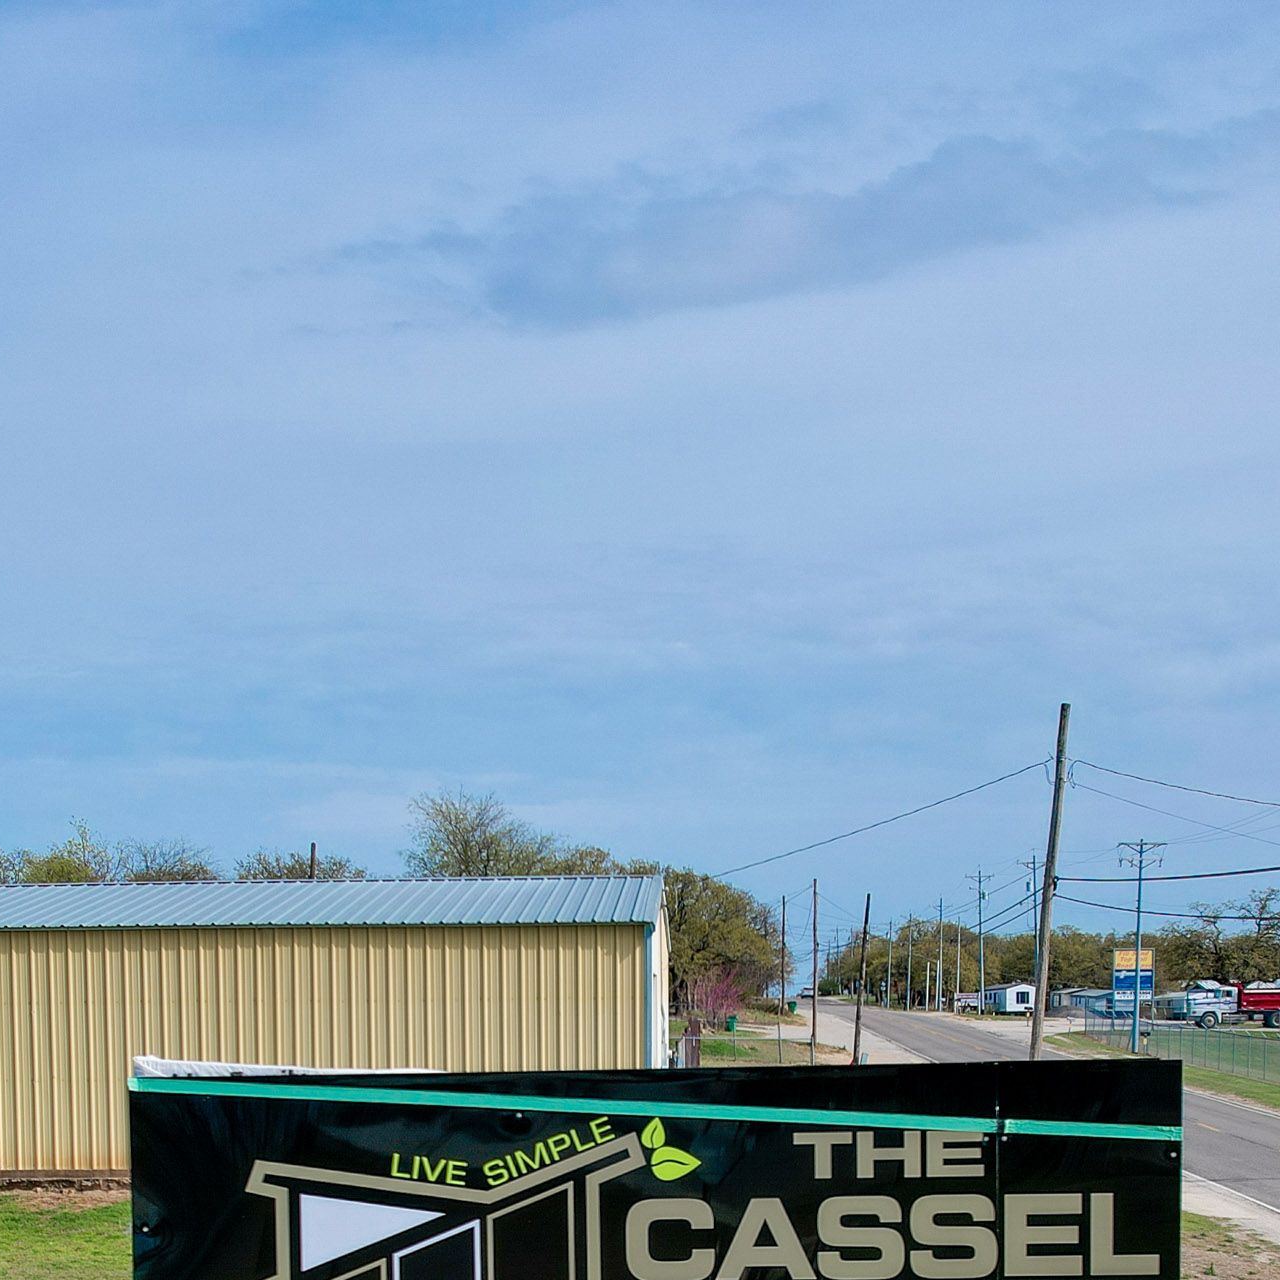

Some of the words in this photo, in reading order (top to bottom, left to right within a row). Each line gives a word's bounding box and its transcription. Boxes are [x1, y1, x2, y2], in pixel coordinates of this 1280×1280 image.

[391, 1153, 469, 1187] LIVE
[483, 1116, 616, 1187] SIMPLE
[793, 1130, 985, 1179] THE
